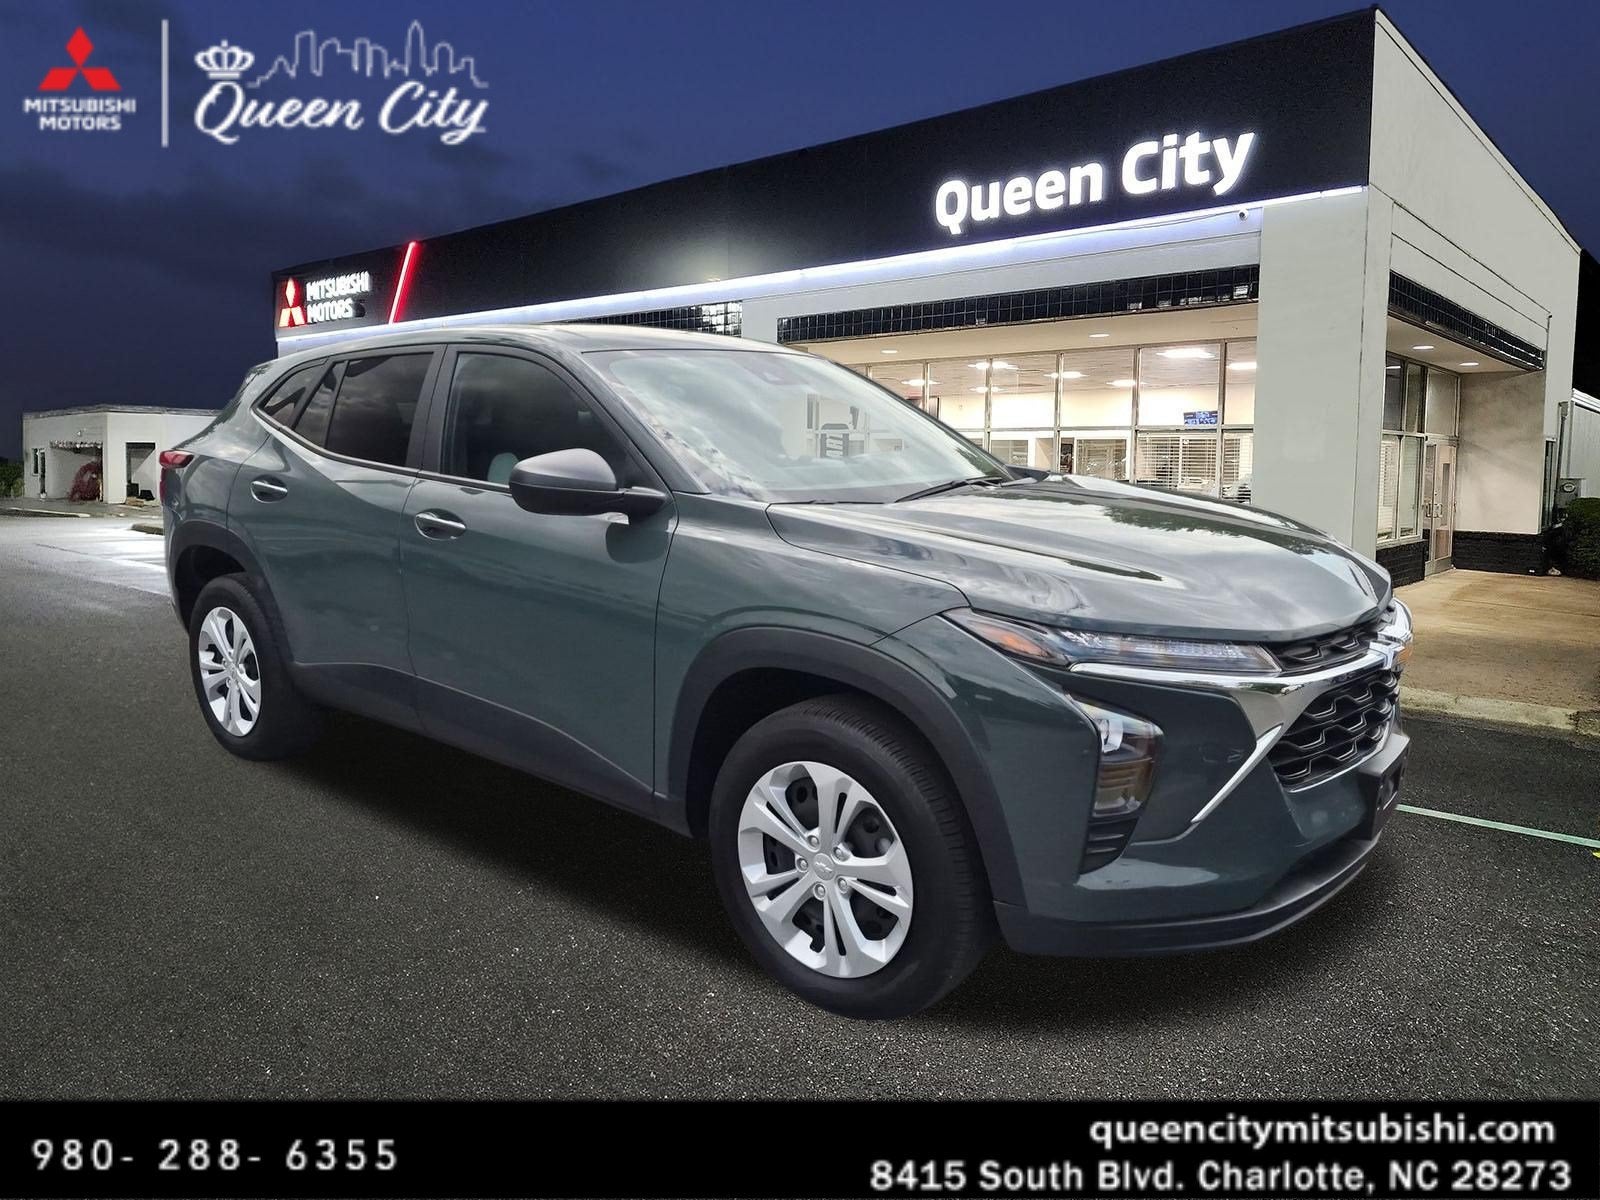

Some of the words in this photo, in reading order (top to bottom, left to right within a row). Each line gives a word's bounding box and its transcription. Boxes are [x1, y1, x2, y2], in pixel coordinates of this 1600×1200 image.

[935, 162, 1103, 235] Queen
[1121, 131, 1256, 196] City
[306, 271, 370, 302] MITSUBISHI
[307, 298, 354, 324] MOTORS
